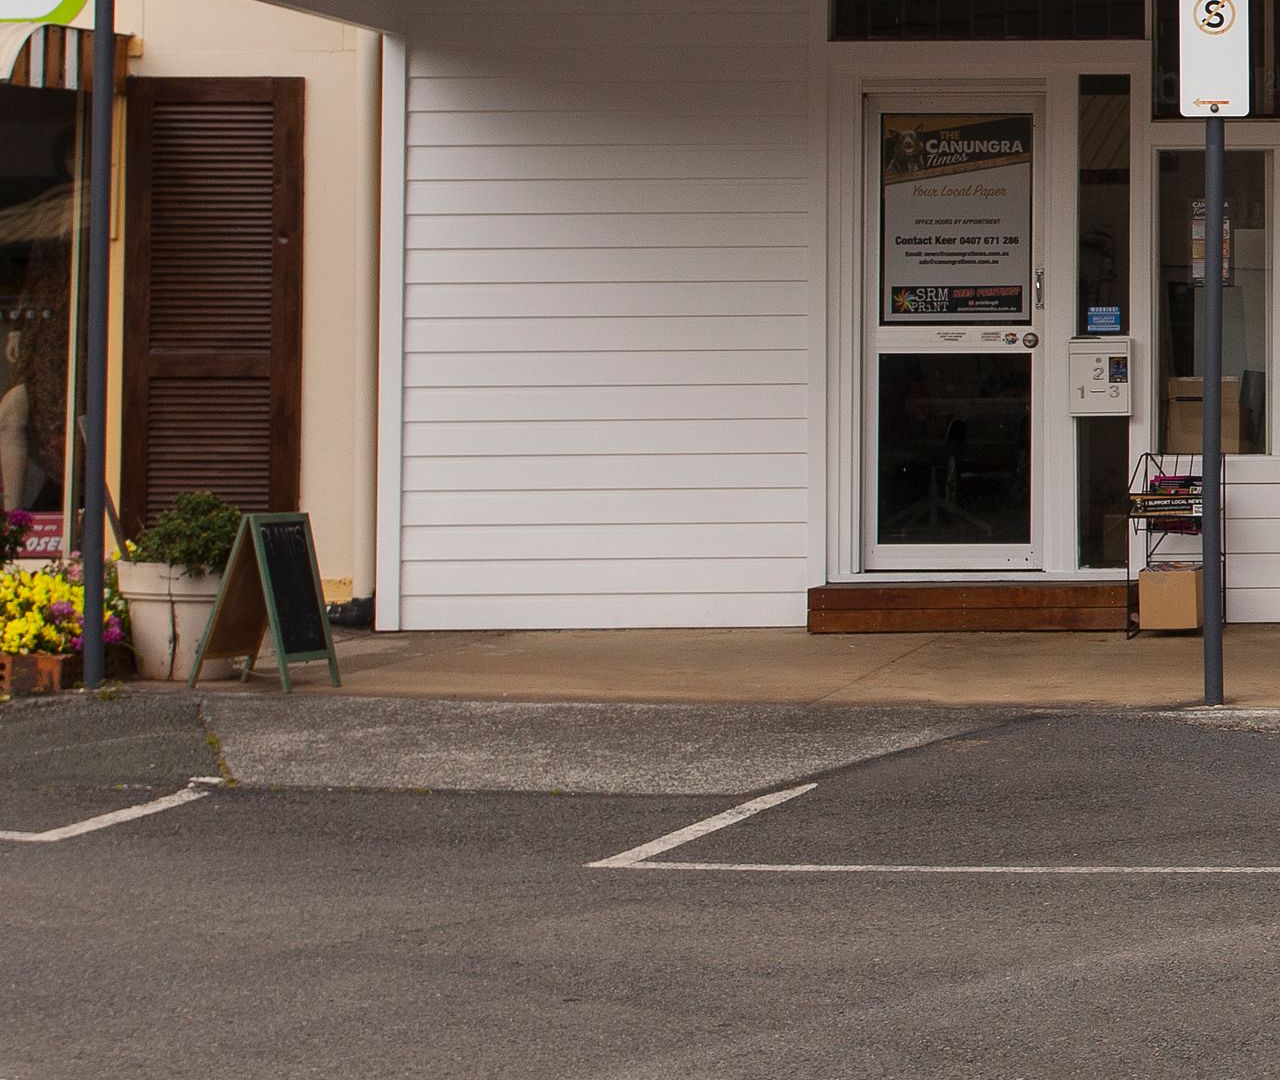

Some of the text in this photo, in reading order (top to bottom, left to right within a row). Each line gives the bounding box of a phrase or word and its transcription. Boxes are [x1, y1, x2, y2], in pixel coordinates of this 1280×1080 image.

[940, 131, 960, 140] THE
[926, 139, 1023, 153] CANUNGRA
[927, 152, 968, 167] Times
[912, 184, 1008, 199] Your Local Paper
[895, 236, 932, 245] Contact
[935, 236, 957, 245] Keer
[960, 236, 981, 245] 0407
[984, 236, 999, 245] 671
[916, 288, 949, 301] SRM
[1093, 367, 1104, 380] 2
